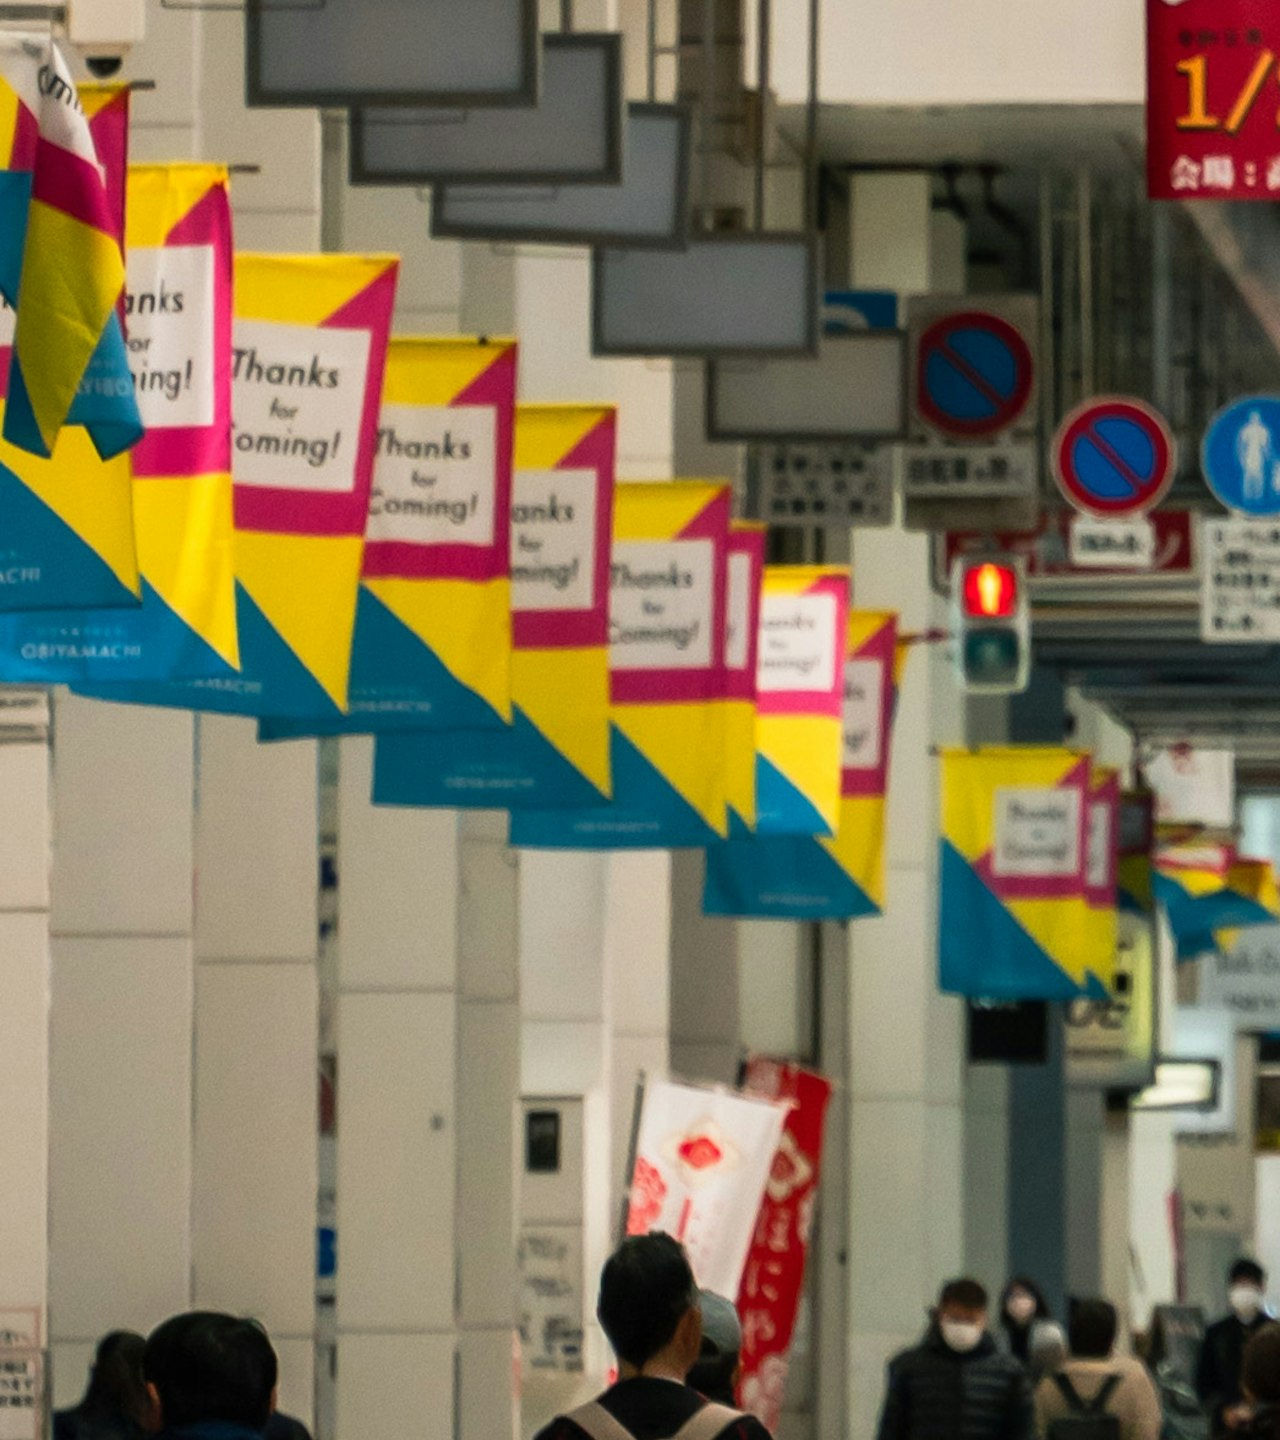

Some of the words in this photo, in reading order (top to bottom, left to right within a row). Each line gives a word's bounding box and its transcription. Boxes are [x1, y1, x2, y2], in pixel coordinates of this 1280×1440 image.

[126, 278, 184, 315] anks
[128, 338, 151, 353] or
[131, 359, 192, 401] ing!
[233, 347, 339, 388] Thanks
[269, 397, 300, 420] for
[234, 426, 341, 467] oming!
[375, 428, 472, 460] Thanks
[369, 488, 479, 525] Coming!
[512, 494, 574, 522] anks
[512, 558, 578, 590] ming!
